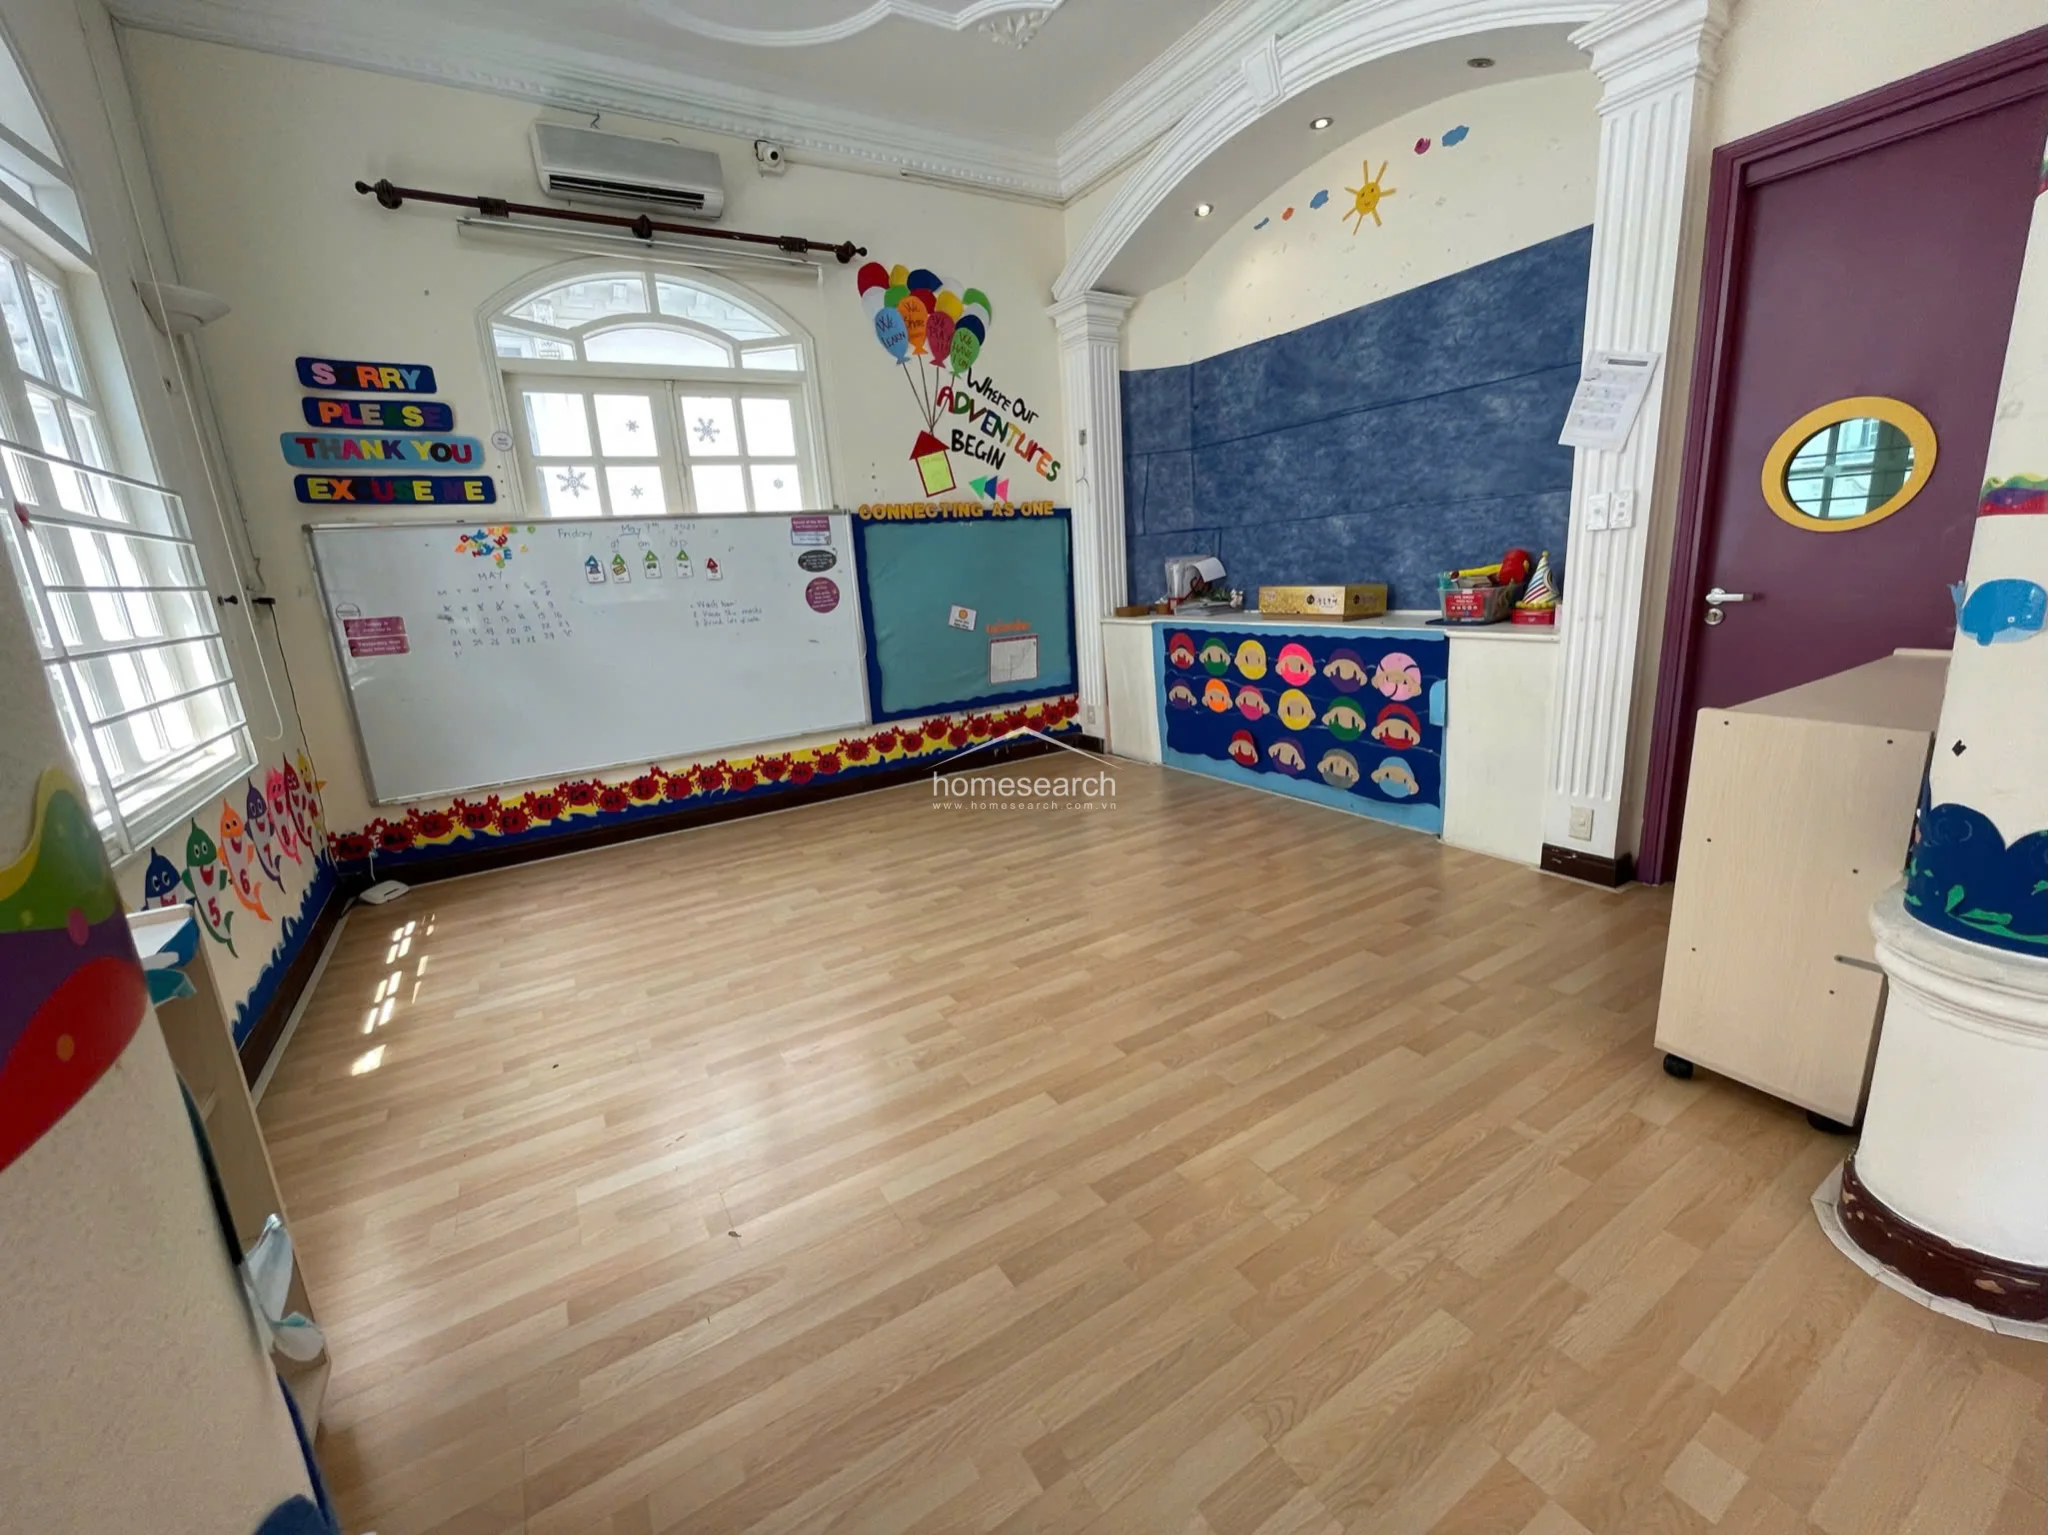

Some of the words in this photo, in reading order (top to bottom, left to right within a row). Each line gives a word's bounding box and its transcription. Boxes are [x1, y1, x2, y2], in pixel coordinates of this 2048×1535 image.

[1012, 398, 1039, 424] Our
[295, 437, 405, 461] THANK
[410, 440, 472, 463] YOU
[950, 428, 1006, 470] BEGIN
[858, 502, 983, 520] CONNECTING
[992, 501, 1015, 517] AS
[1021, 500, 1054, 516] ONE
[557, 527, 593, 539] Friday
[620, 523, 641, 538] May
[478, 570, 502, 581] MAY
[264, 844, 273, 868] 7
[240, 868, 250, 896] 6
[208, 897, 221, 928] 5
